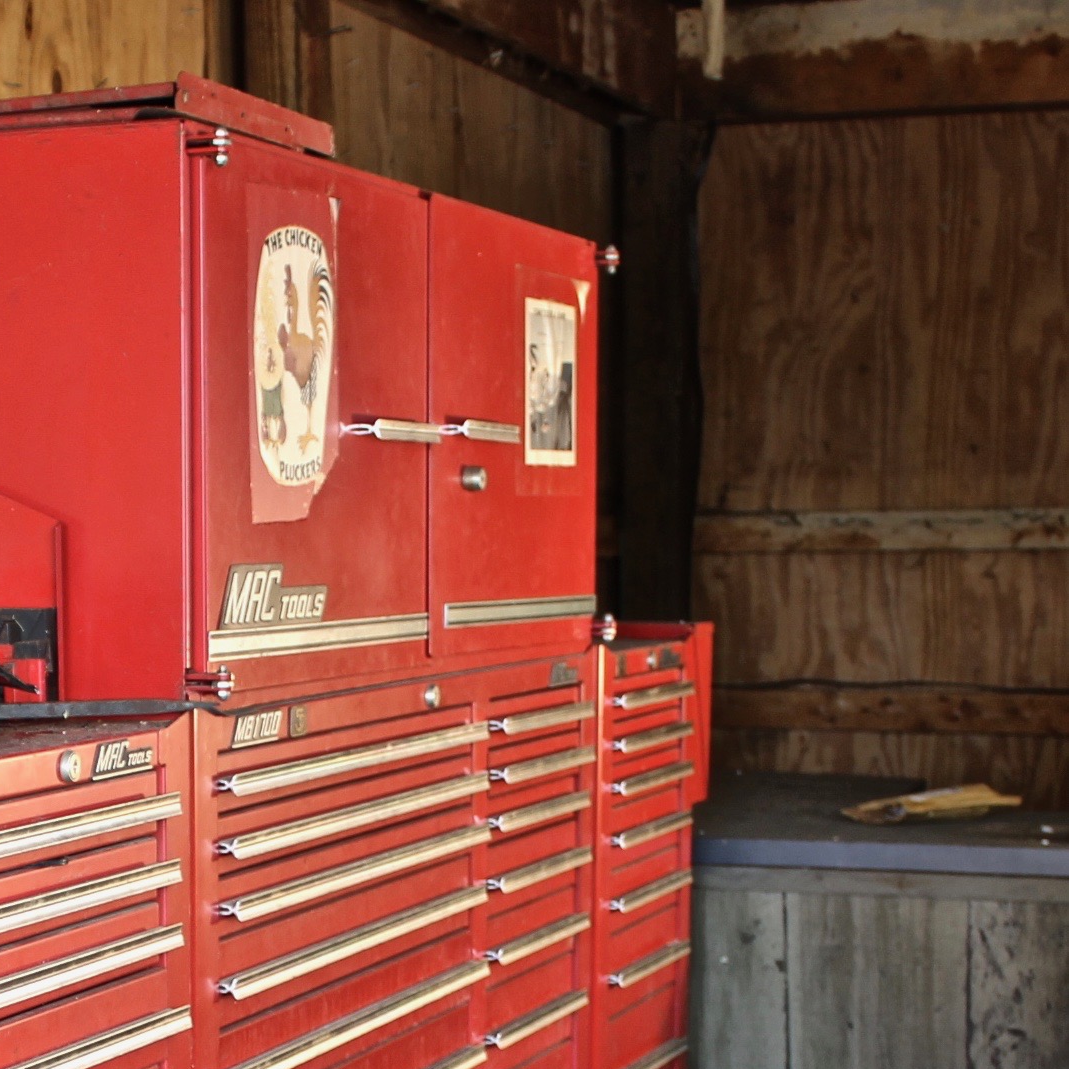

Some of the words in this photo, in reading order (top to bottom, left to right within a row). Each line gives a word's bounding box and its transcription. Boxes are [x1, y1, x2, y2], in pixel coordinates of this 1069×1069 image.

[264, 231, 283, 256] THE
[284, 229, 323, 256] CHICKEN
[279, 456, 321, 480] PLUCKERS
[224, 570, 281, 624] MAC
[280, 593, 325, 620] TOOLS
[95, 741, 130, 773] MAC
[127, 749, 153, 767] TOOLS
